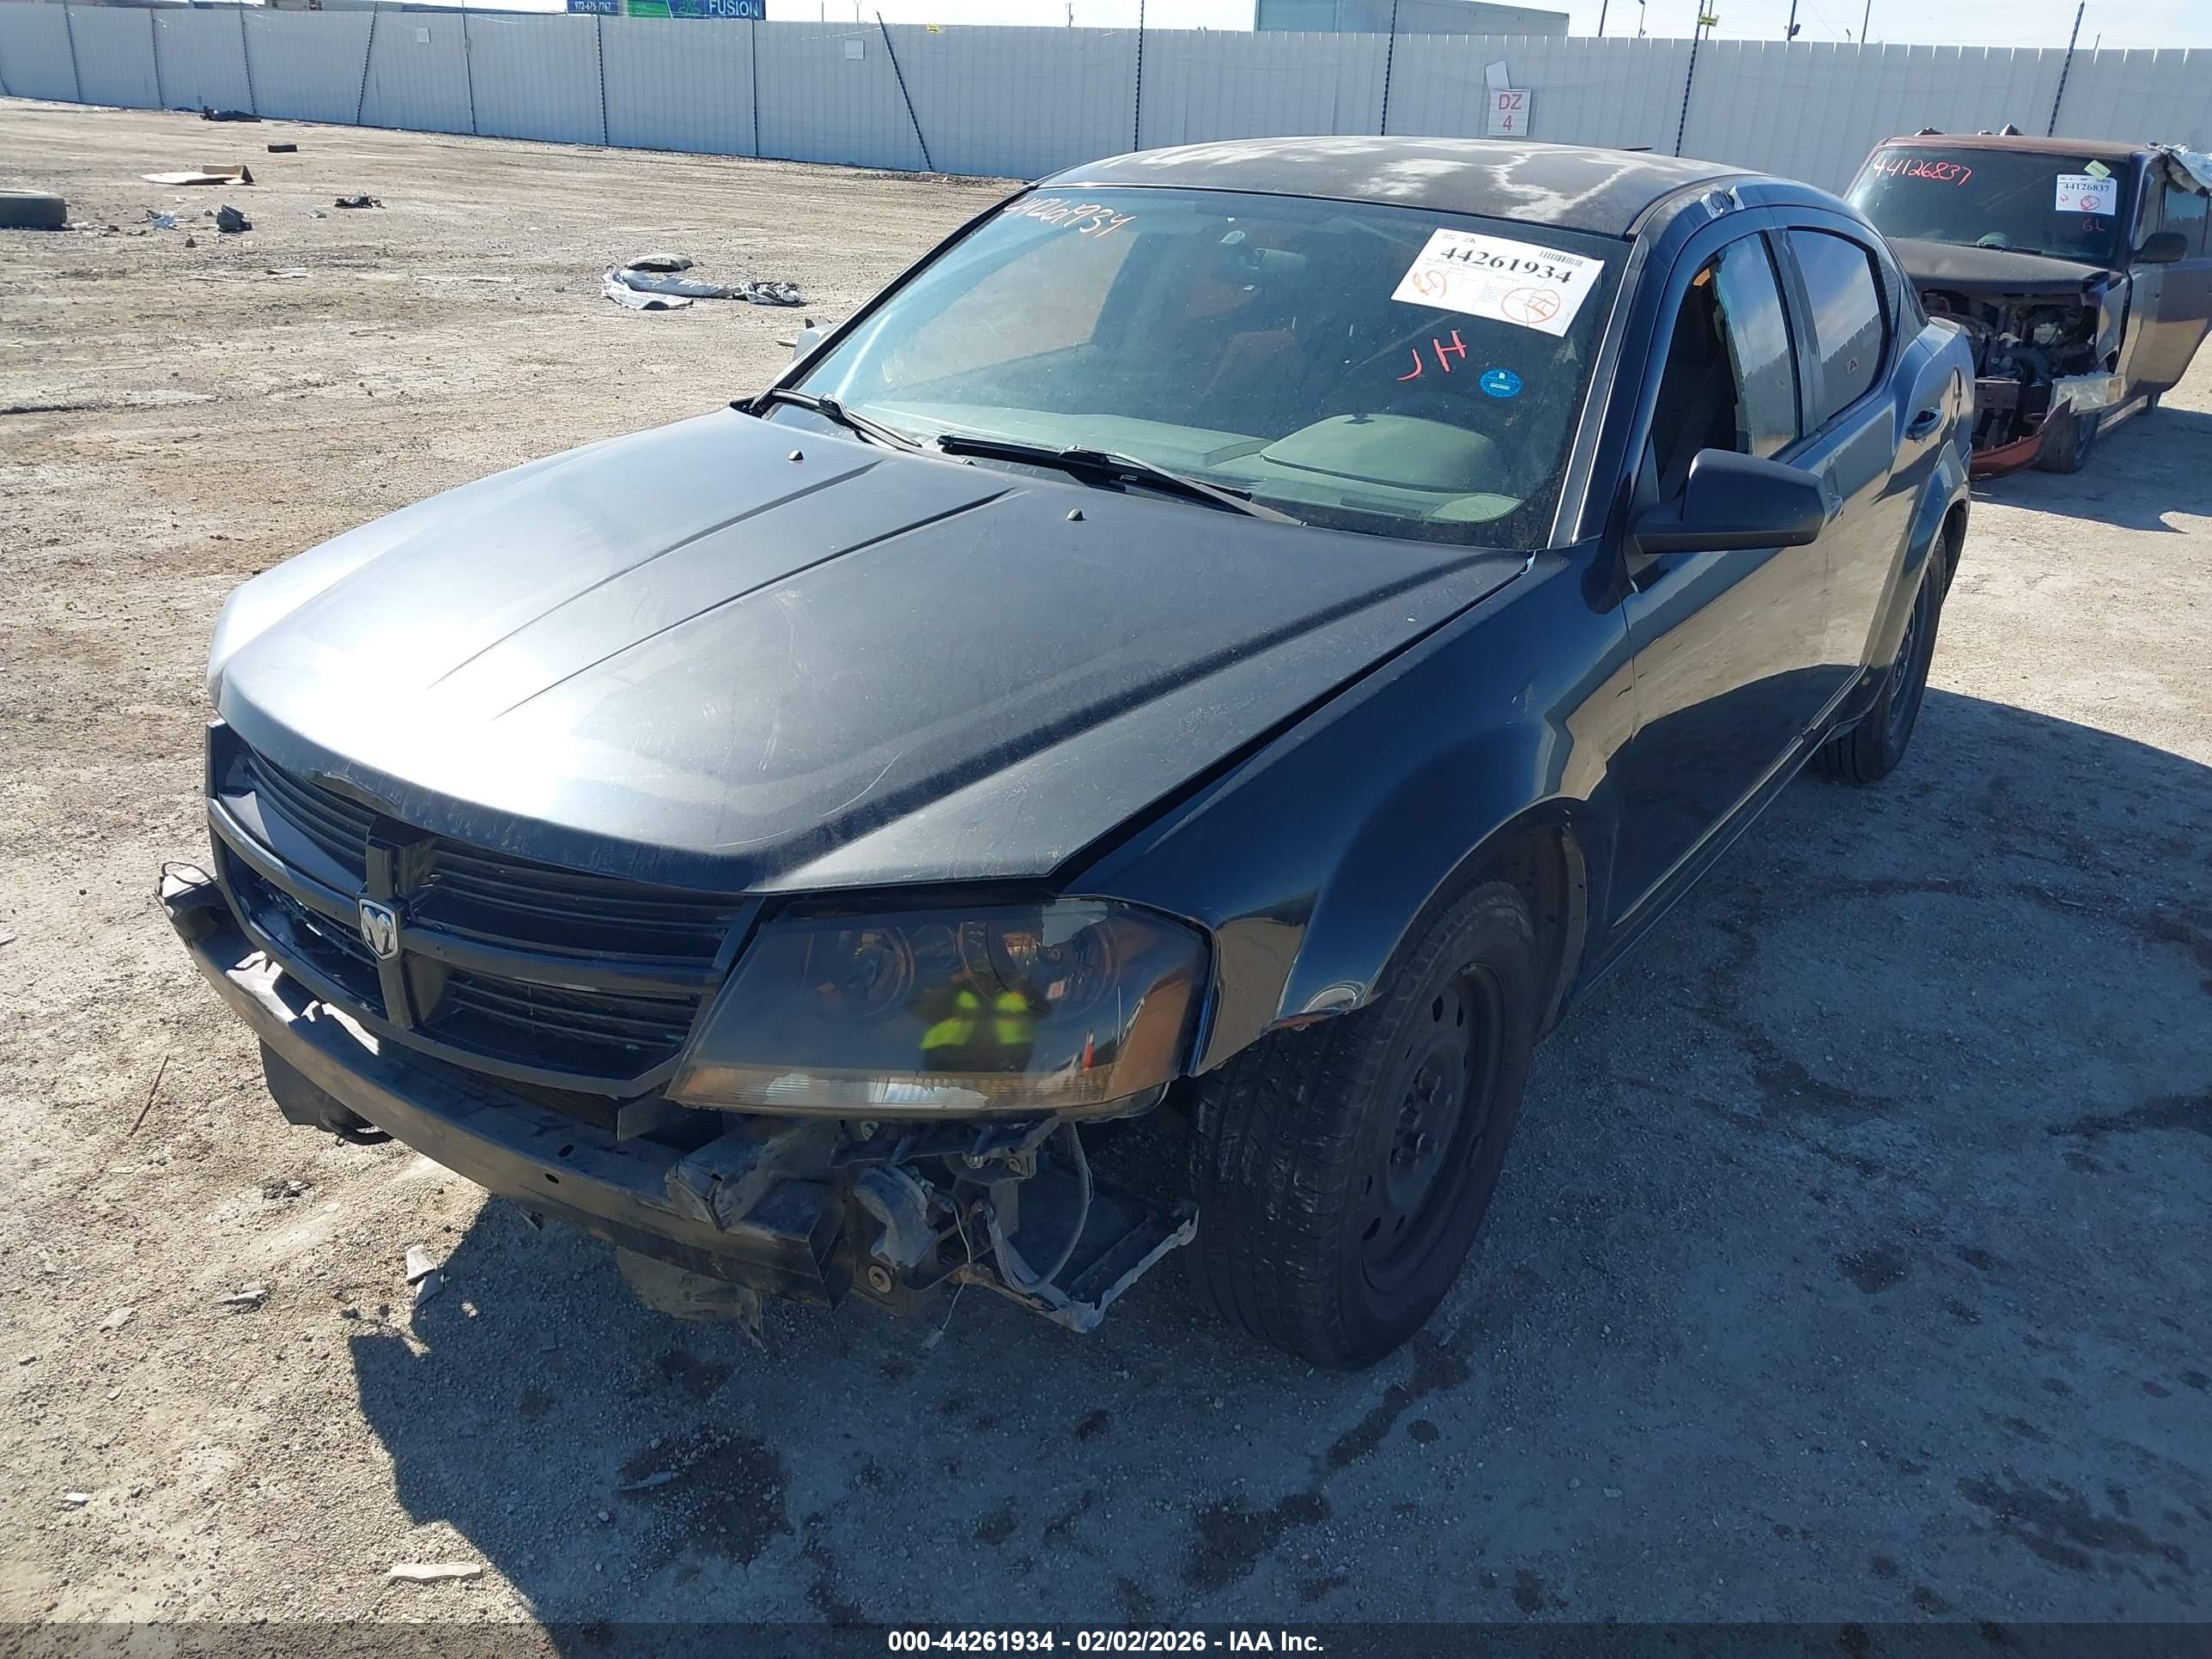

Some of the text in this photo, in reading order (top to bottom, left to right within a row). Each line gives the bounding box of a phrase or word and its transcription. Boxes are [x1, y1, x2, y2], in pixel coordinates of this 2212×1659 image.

[709, 0, 758, 16] FUSION
[1498, 94, 1523, 110] DZ
[1502, 114, 1513, 131] 4
[1873, 158, 1972, 185] 44126837
[2063, 183, 2110, 192] 44126837
[1440, 246, 1573, 283] 44261934
